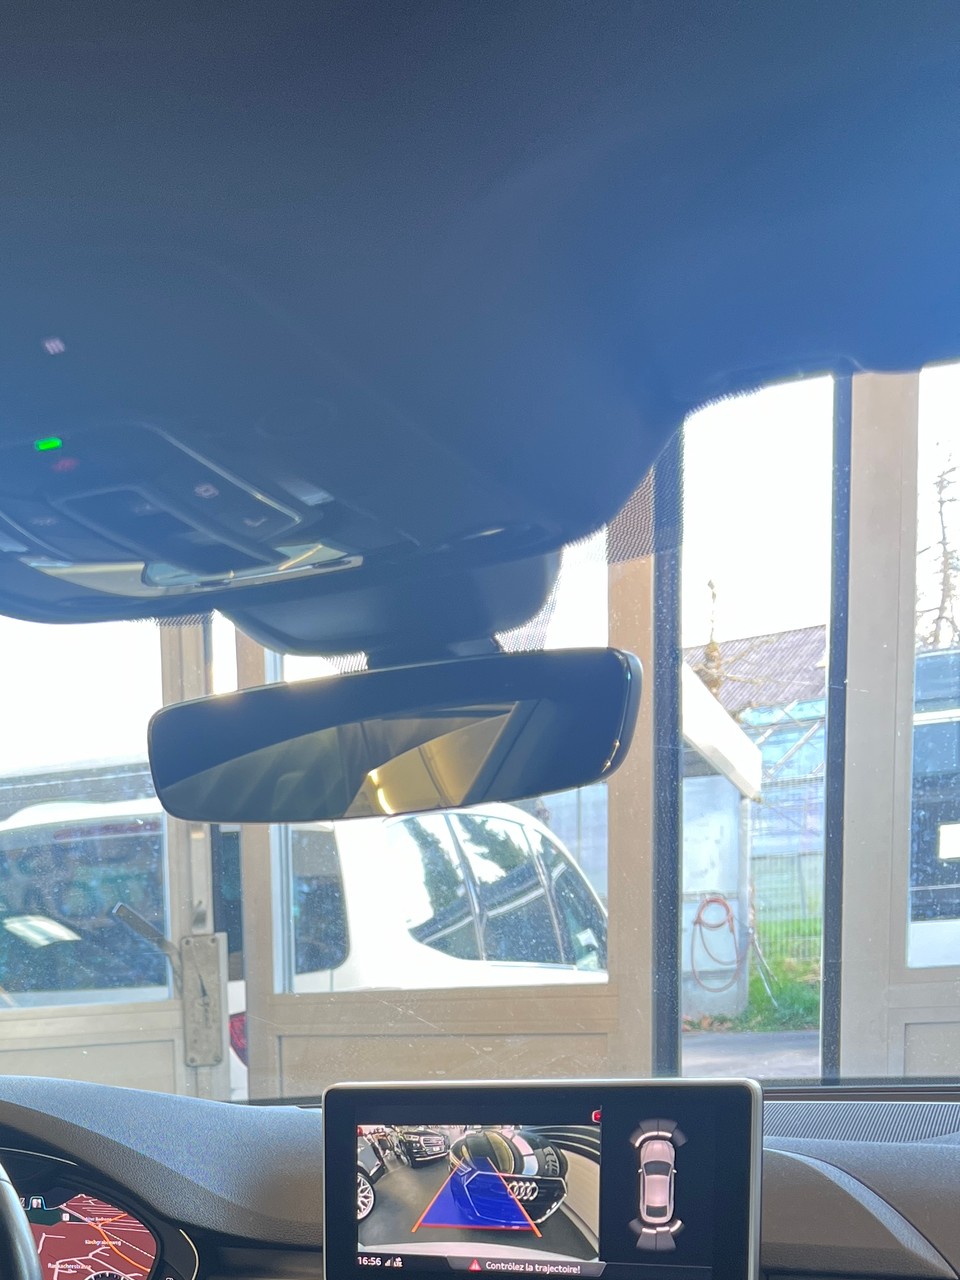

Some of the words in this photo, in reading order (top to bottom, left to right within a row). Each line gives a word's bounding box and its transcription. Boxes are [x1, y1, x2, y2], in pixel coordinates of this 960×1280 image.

[357, 1256, 382, 1266] 16:56
[485, 1260, 524, 1272] Contrôlez
[525, 1262, 534, 1272] la
[535, 1263, 581, 1275] trajectoire!
